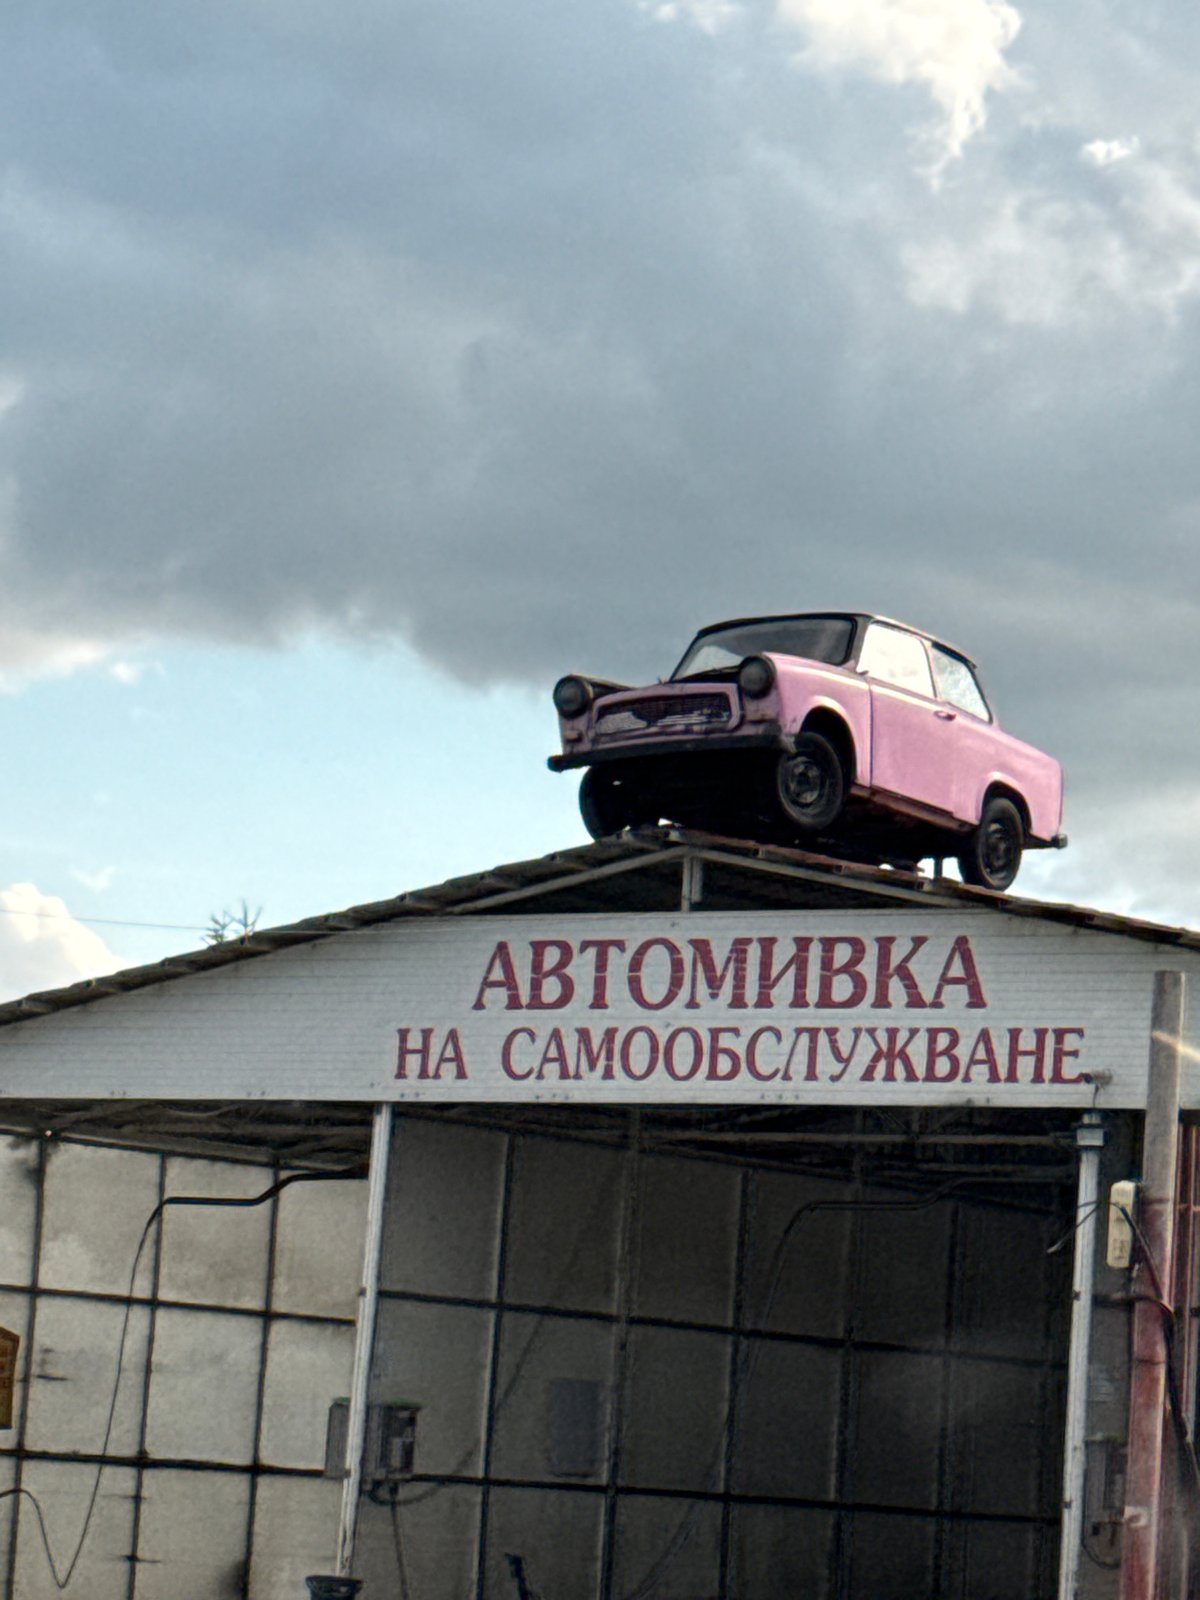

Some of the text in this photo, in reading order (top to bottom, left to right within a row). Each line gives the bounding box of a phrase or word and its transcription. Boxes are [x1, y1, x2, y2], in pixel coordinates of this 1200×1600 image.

[473, 935, 988, 1010] АВТОМИВКА
[395, 1025, 1084, 1083] НА САМООБСЛУЖВАНЕ
